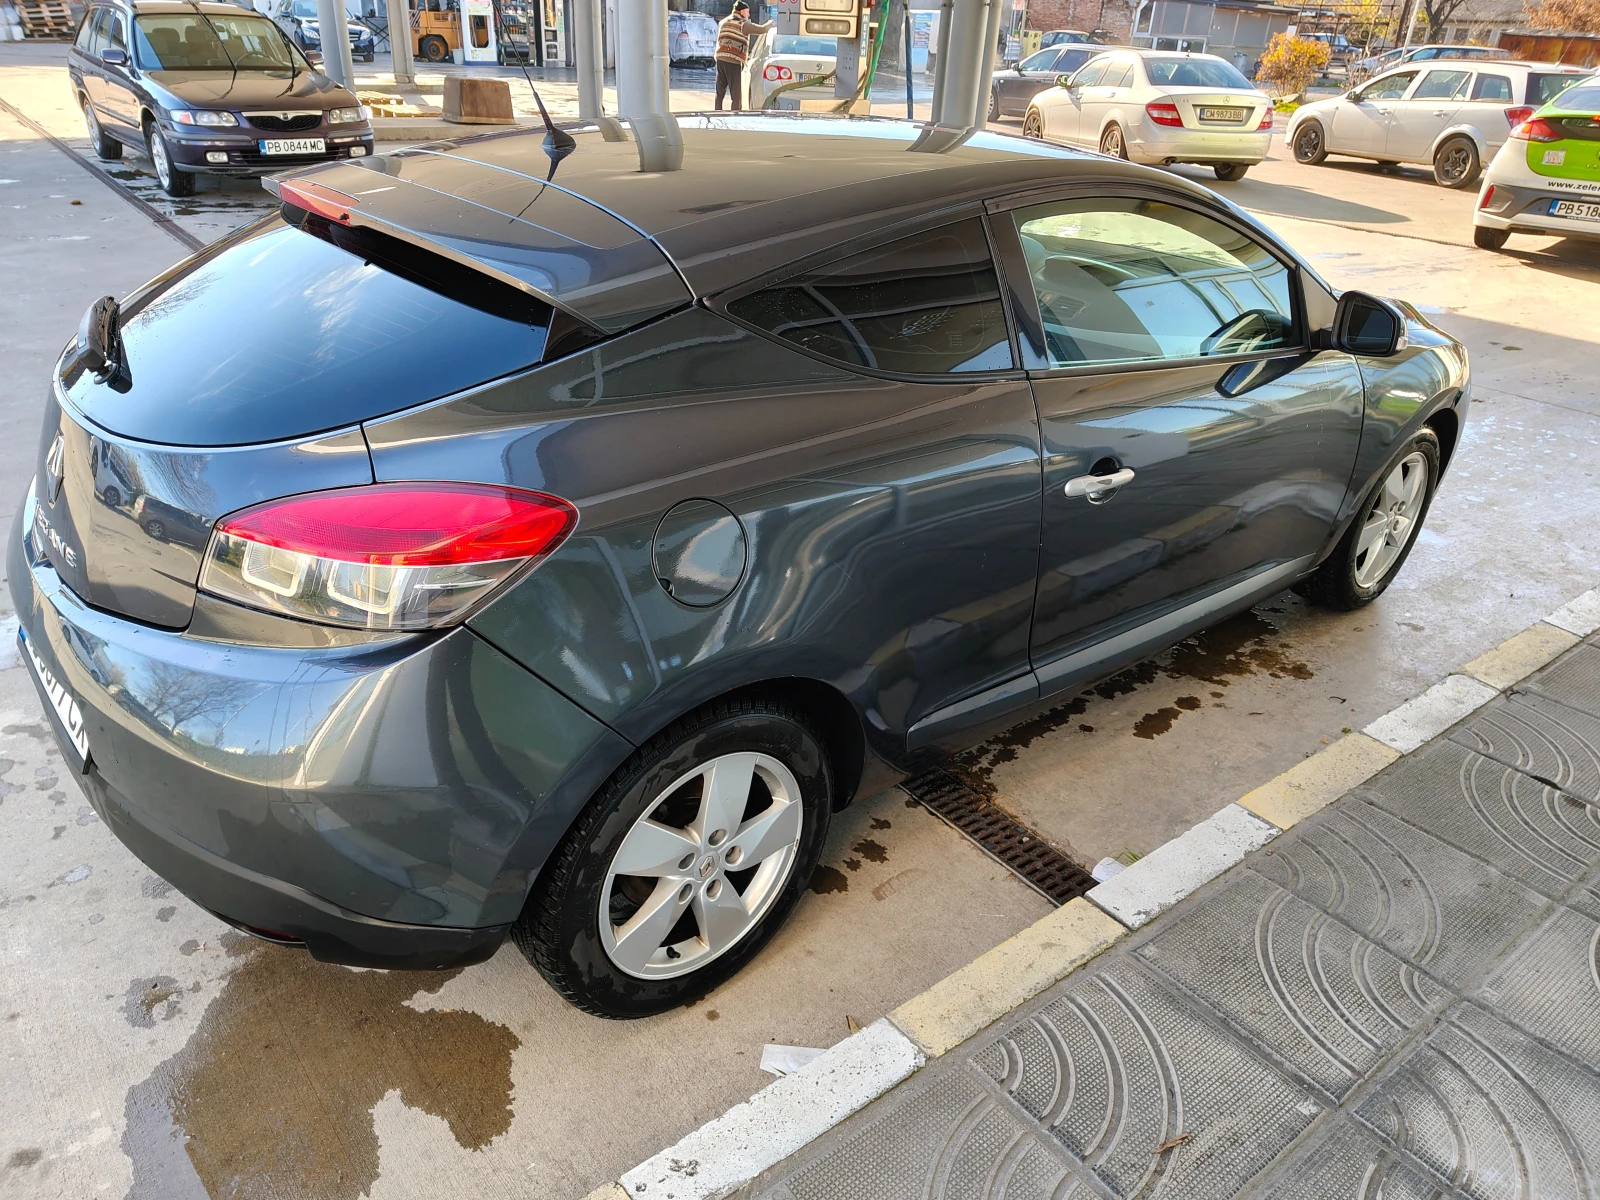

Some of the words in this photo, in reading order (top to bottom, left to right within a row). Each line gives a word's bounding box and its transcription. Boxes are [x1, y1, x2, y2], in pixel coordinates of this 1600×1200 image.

[1216, 110, 1232, 119] 9873
[1233, 111, 1242, 119] BB
[267, 141, 281, 152] PB
[284, 141, 308, 151] 0844
[310, 140, 324, 151] MC
[1556, 202, 1575, 215] PB
[1575, 204, 1600, 218] 518
